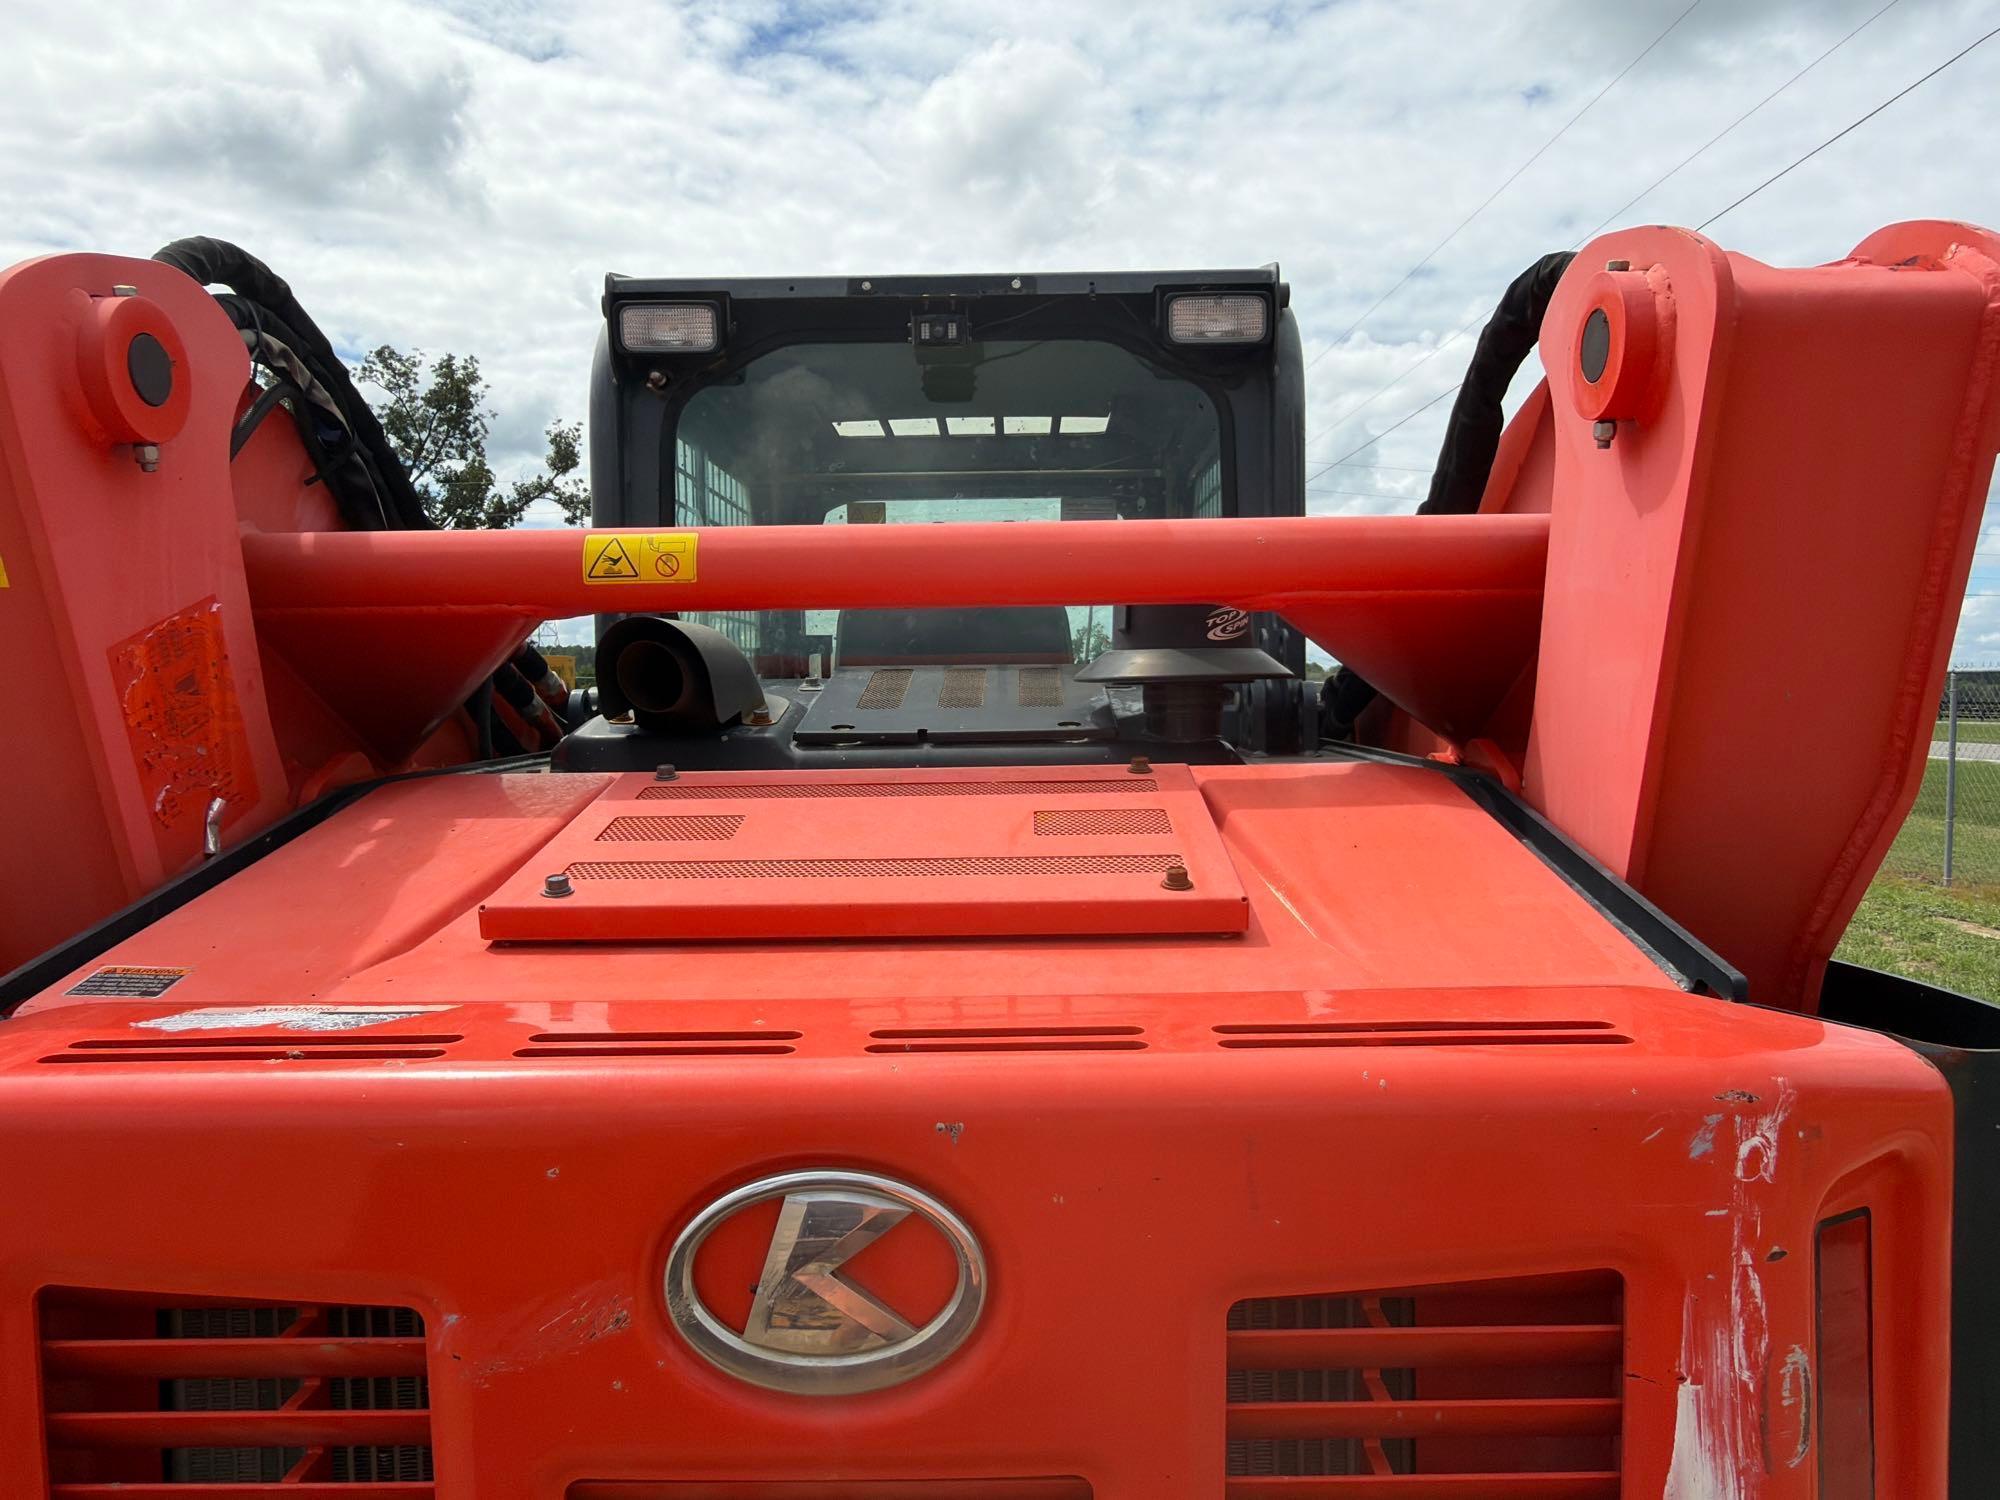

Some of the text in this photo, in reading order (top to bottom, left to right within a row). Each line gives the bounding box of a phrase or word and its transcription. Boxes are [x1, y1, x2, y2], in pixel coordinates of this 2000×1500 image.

[1205, 611, 1237, 627] TOP
[1224, 616, 1249, 633] SPIN
[121, 967, 183, 976] WARNING
[743, 1190, 919, 1356] K
